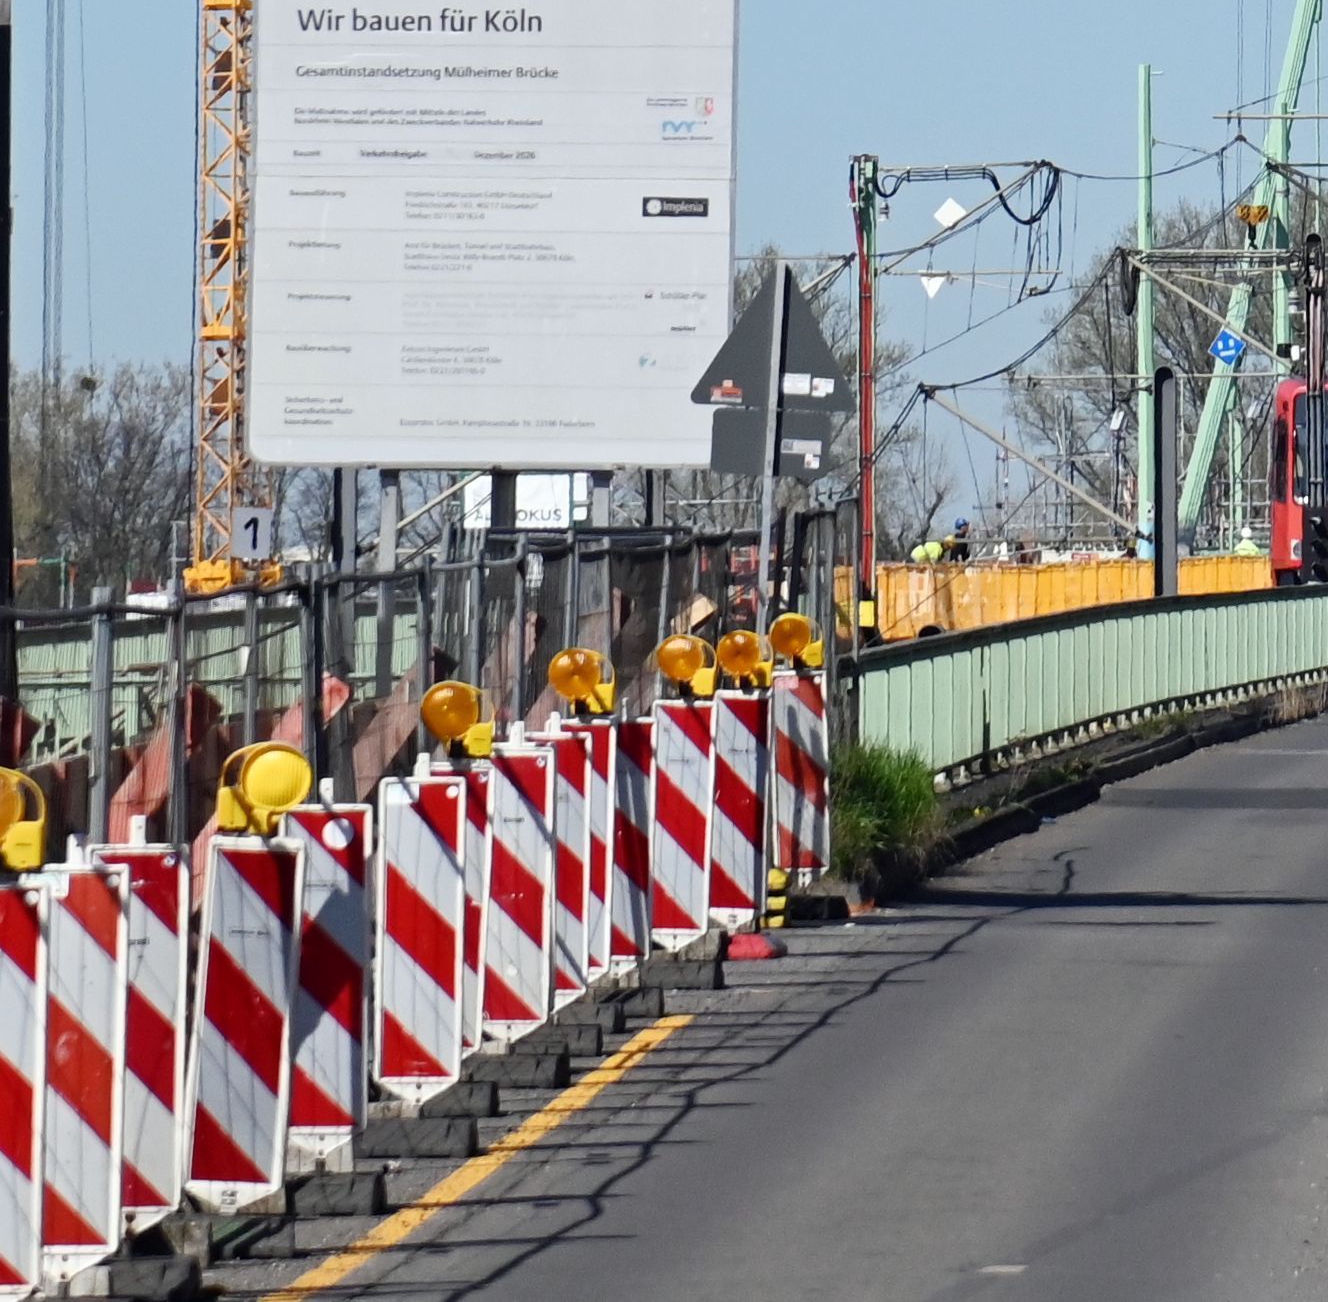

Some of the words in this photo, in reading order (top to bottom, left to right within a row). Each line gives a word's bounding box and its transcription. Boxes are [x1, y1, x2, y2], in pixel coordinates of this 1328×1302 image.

[297, 10, 345, 32] Wir
[352, 9, 432, 32] bauen
[439, 9, 478, 32] für
[484, 10, 543, 32] Köln
[295, 65, 441, 80] Gesamtinstandsetzung
[444, 65, 513, 79] Mülheimer
[516, 66, 559, 79] Brücke
[516, 509, 562, 522] OKUS
[244, 517, 259, 550] 1
